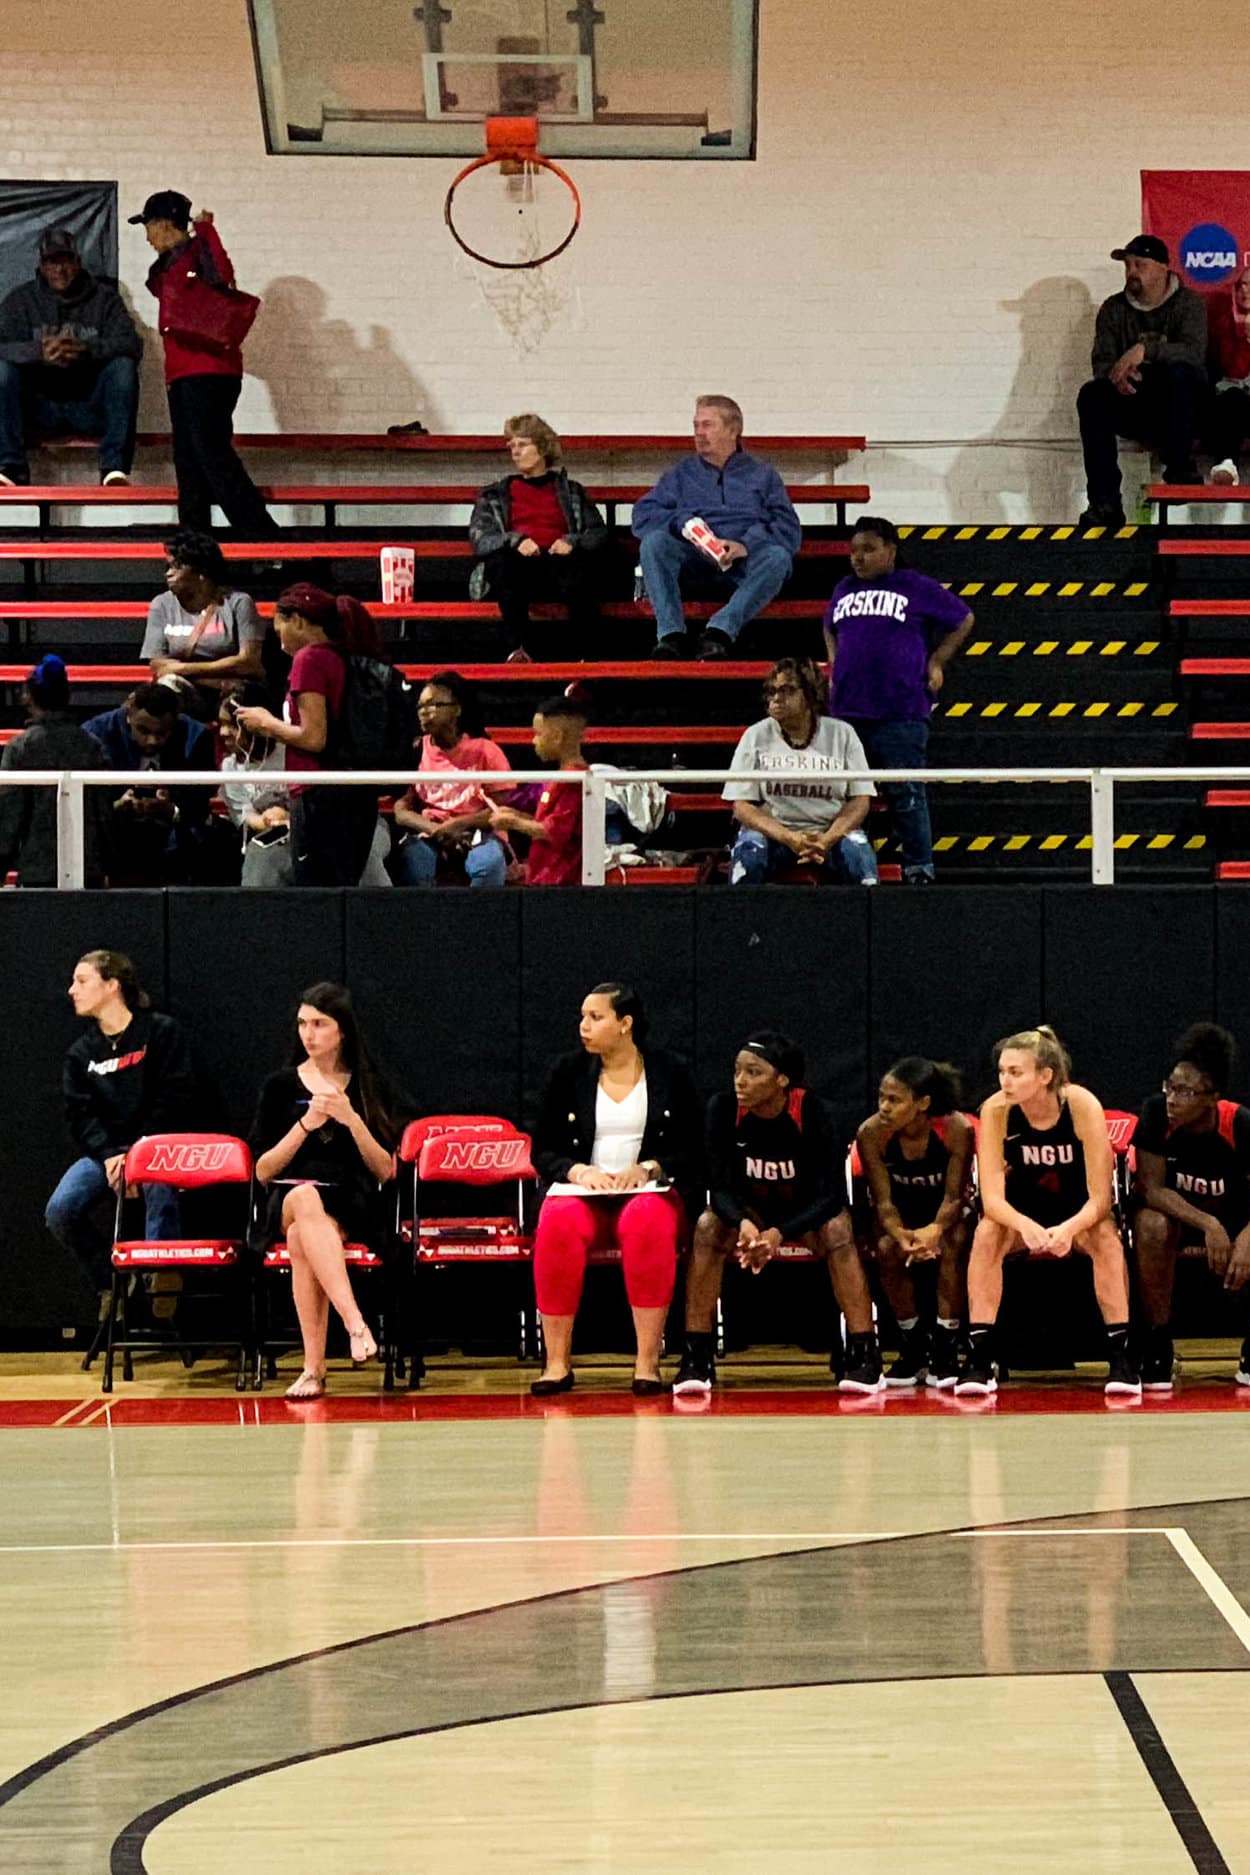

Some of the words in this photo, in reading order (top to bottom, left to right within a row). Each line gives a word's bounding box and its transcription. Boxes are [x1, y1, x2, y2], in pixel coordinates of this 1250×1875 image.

[1185, 252, 1237, 268] NCAA
[832, 590, 909, 624] ERSKINE
[147, 1142, 234, 1172] NGU
[440, 1140, 525, 1170] NGU
[1021, 1144, 1073, 1166] NGU
[746, 1156, 796, 1181] NGU
[1176, 1171, 1225, 1197] NGU
